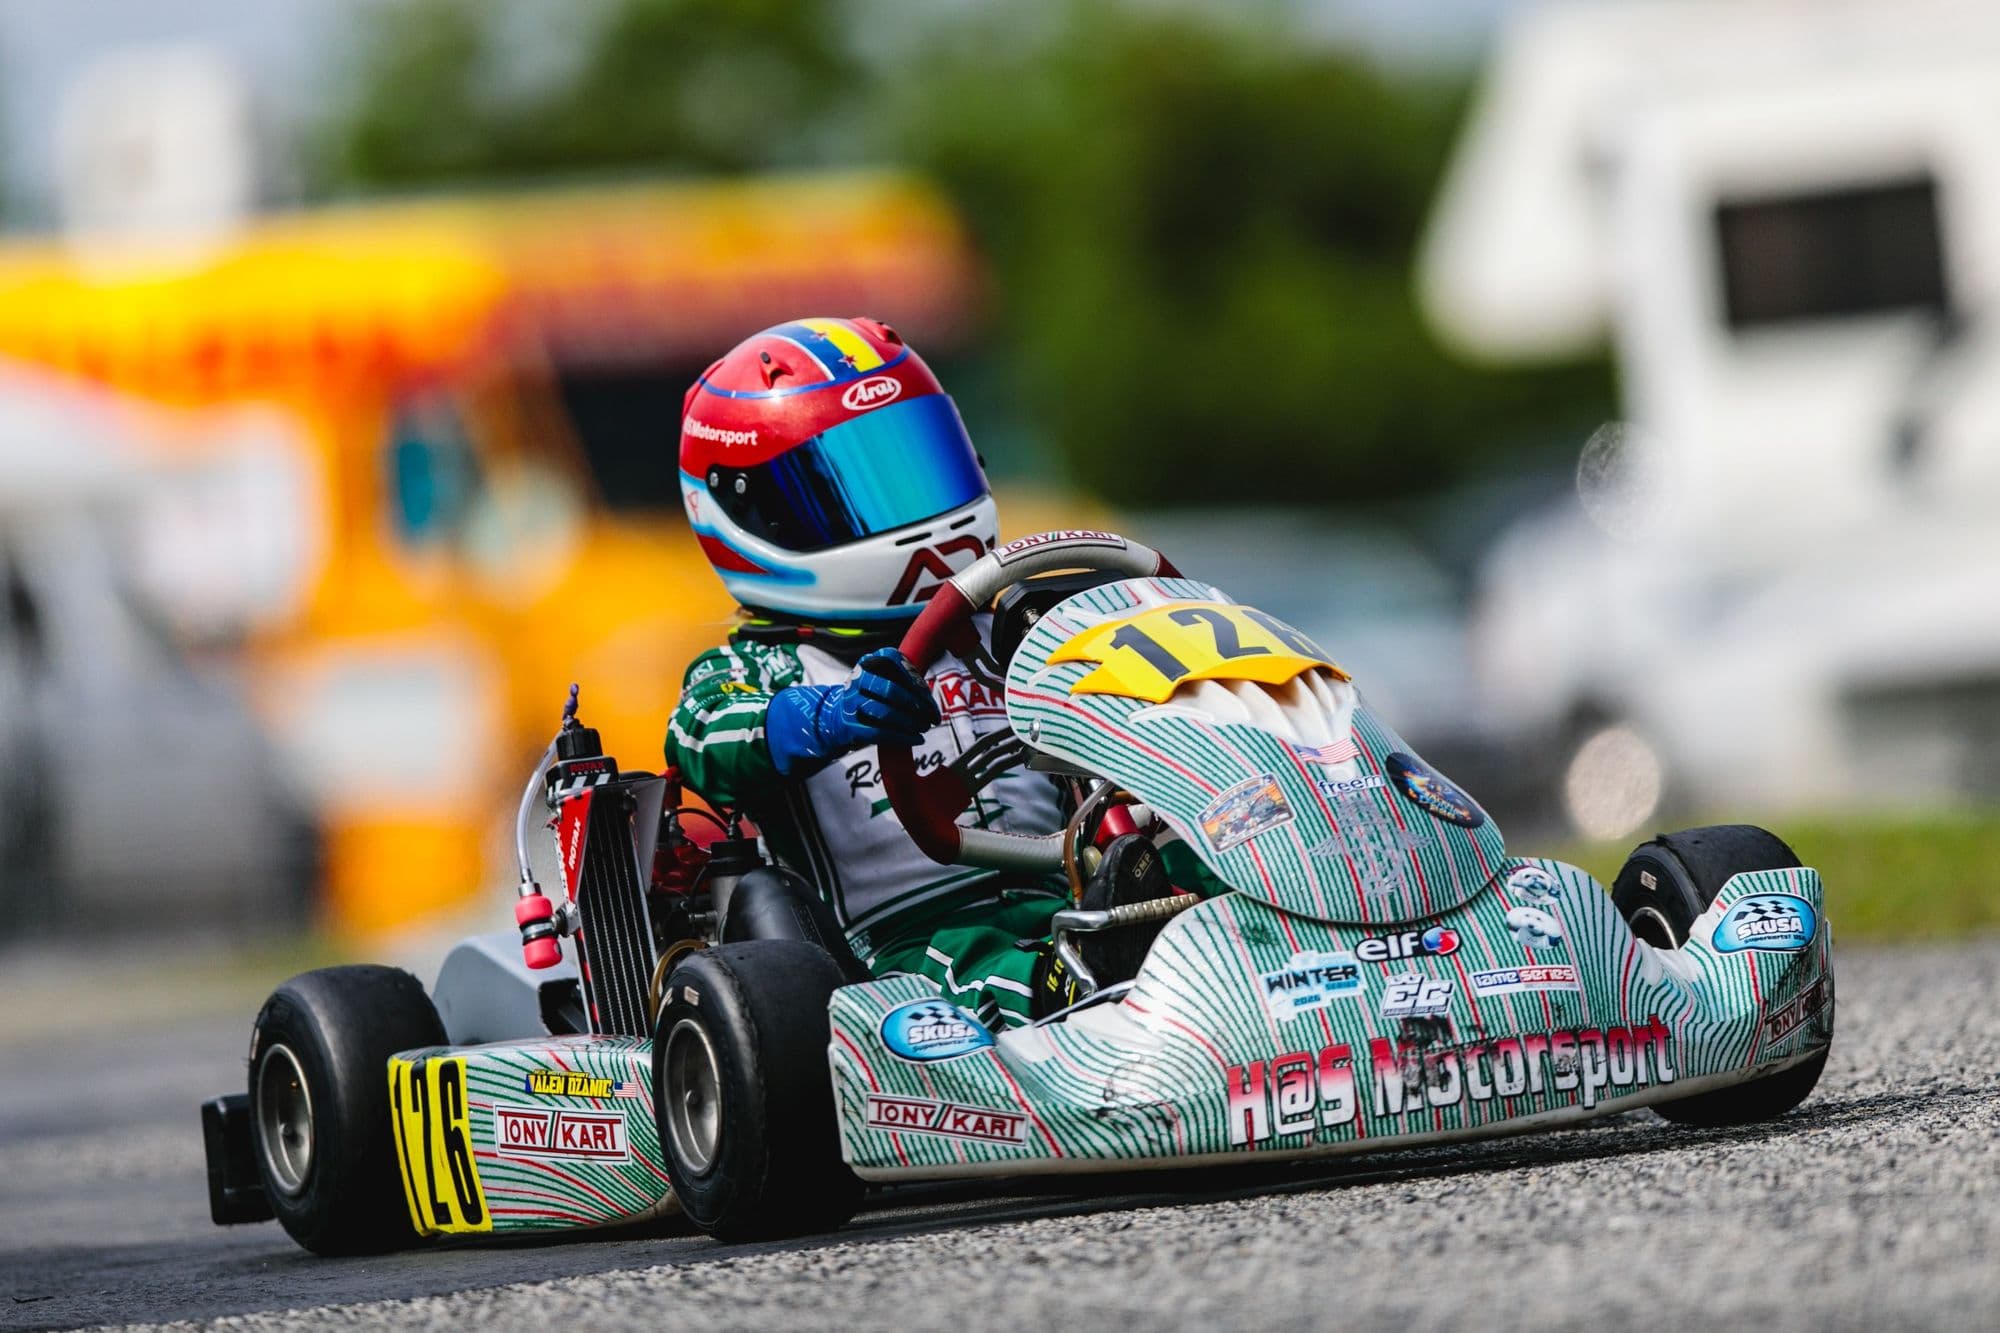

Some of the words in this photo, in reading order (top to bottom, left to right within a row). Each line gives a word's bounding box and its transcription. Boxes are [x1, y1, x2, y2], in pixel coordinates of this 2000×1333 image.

[847, 378, 896, 407] Arai
[1110, 608, 1337, 682] 126
[1318, 776, 1385, 796] freem
[1133, 851, 1151, 879] OMP
[1738, 917, 1804, 940] SKUSA
[1357, 932, 1421, 960] elf
[1266, 965, 1360, 993] WINTER
[908, 1022, 978, 1045] SKUSA
[1370, 1014, 1674, 1118] Motorsport
[534, 1074, 565, 1095] ALEN
[498, 1101, 548, 1145] TONY
[562, 1116, 621, 1150] KART
[869, 1098, 937, 1126] TONY
[952, 1108, 1025, 1138] KART
[394, 1059, 483, 1231] 126
